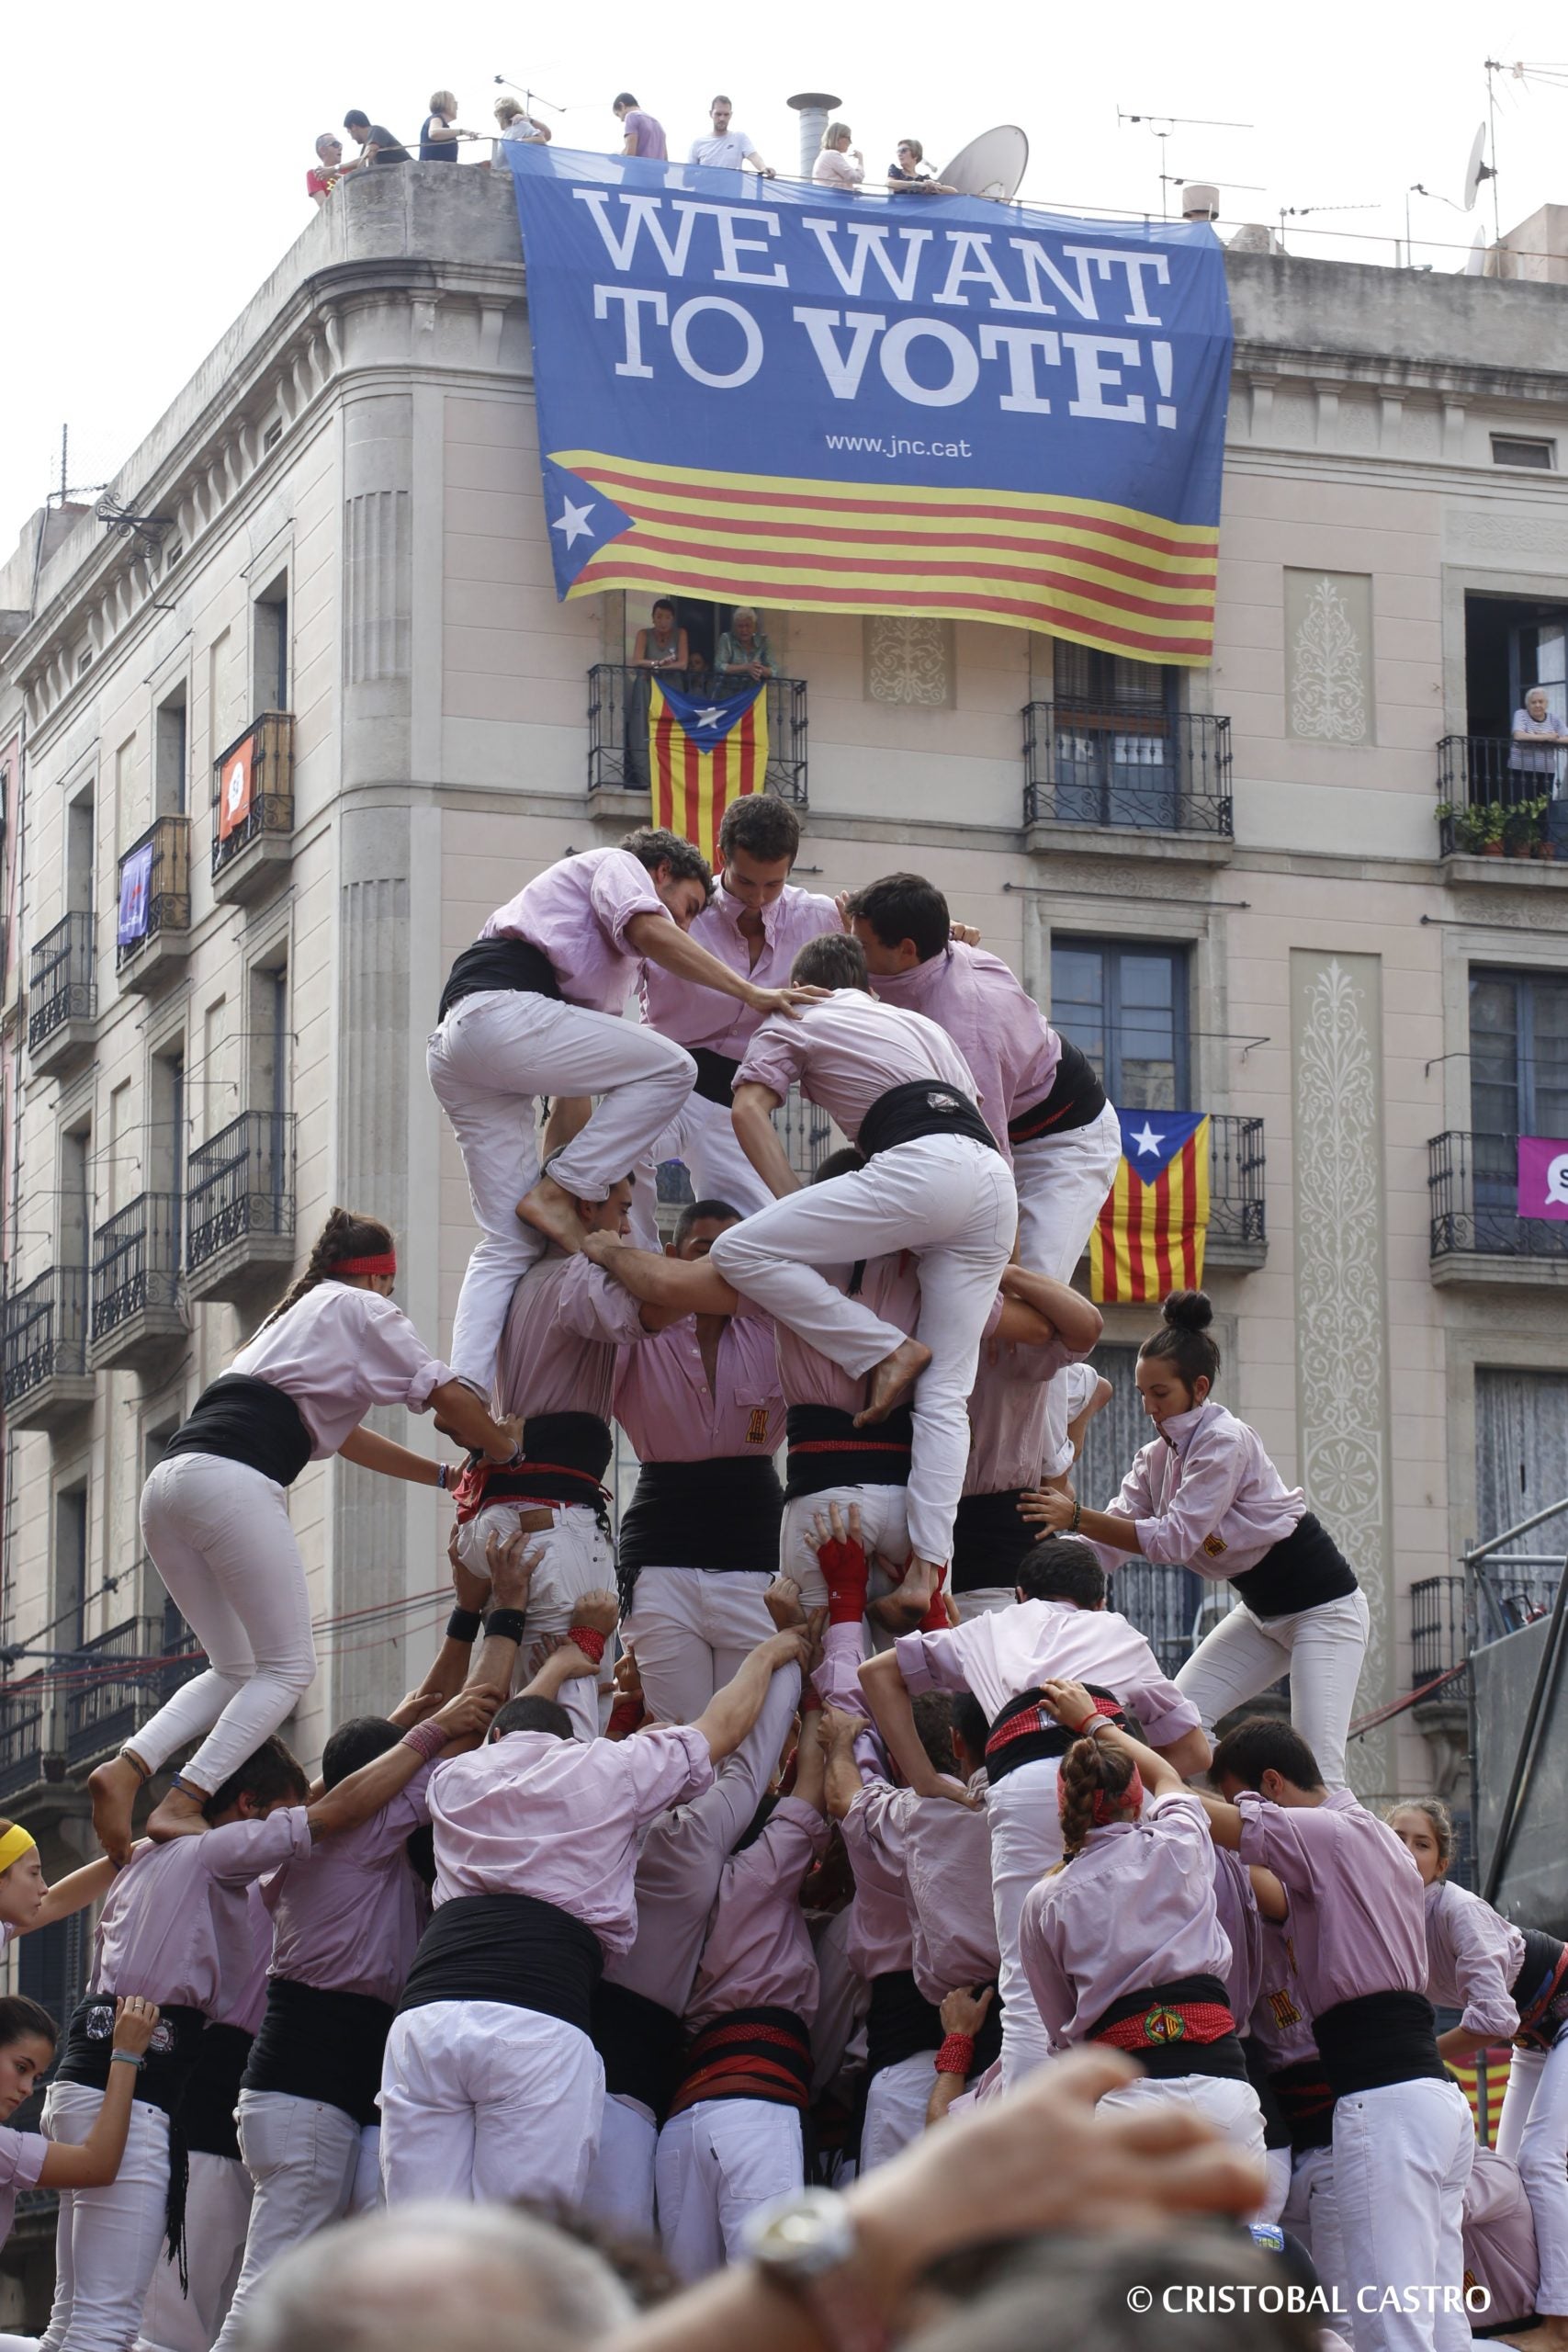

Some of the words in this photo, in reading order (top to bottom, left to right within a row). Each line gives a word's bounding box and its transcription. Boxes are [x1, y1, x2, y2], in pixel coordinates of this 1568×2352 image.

[572, 187, 789, 288] WE
[801, 217, 1171, 326] WANT
[593, 284, 764, 389] TO
[792, 306, 1178, 430] VOTE!
[825, 435, 972, 458] www.jnc.cat
